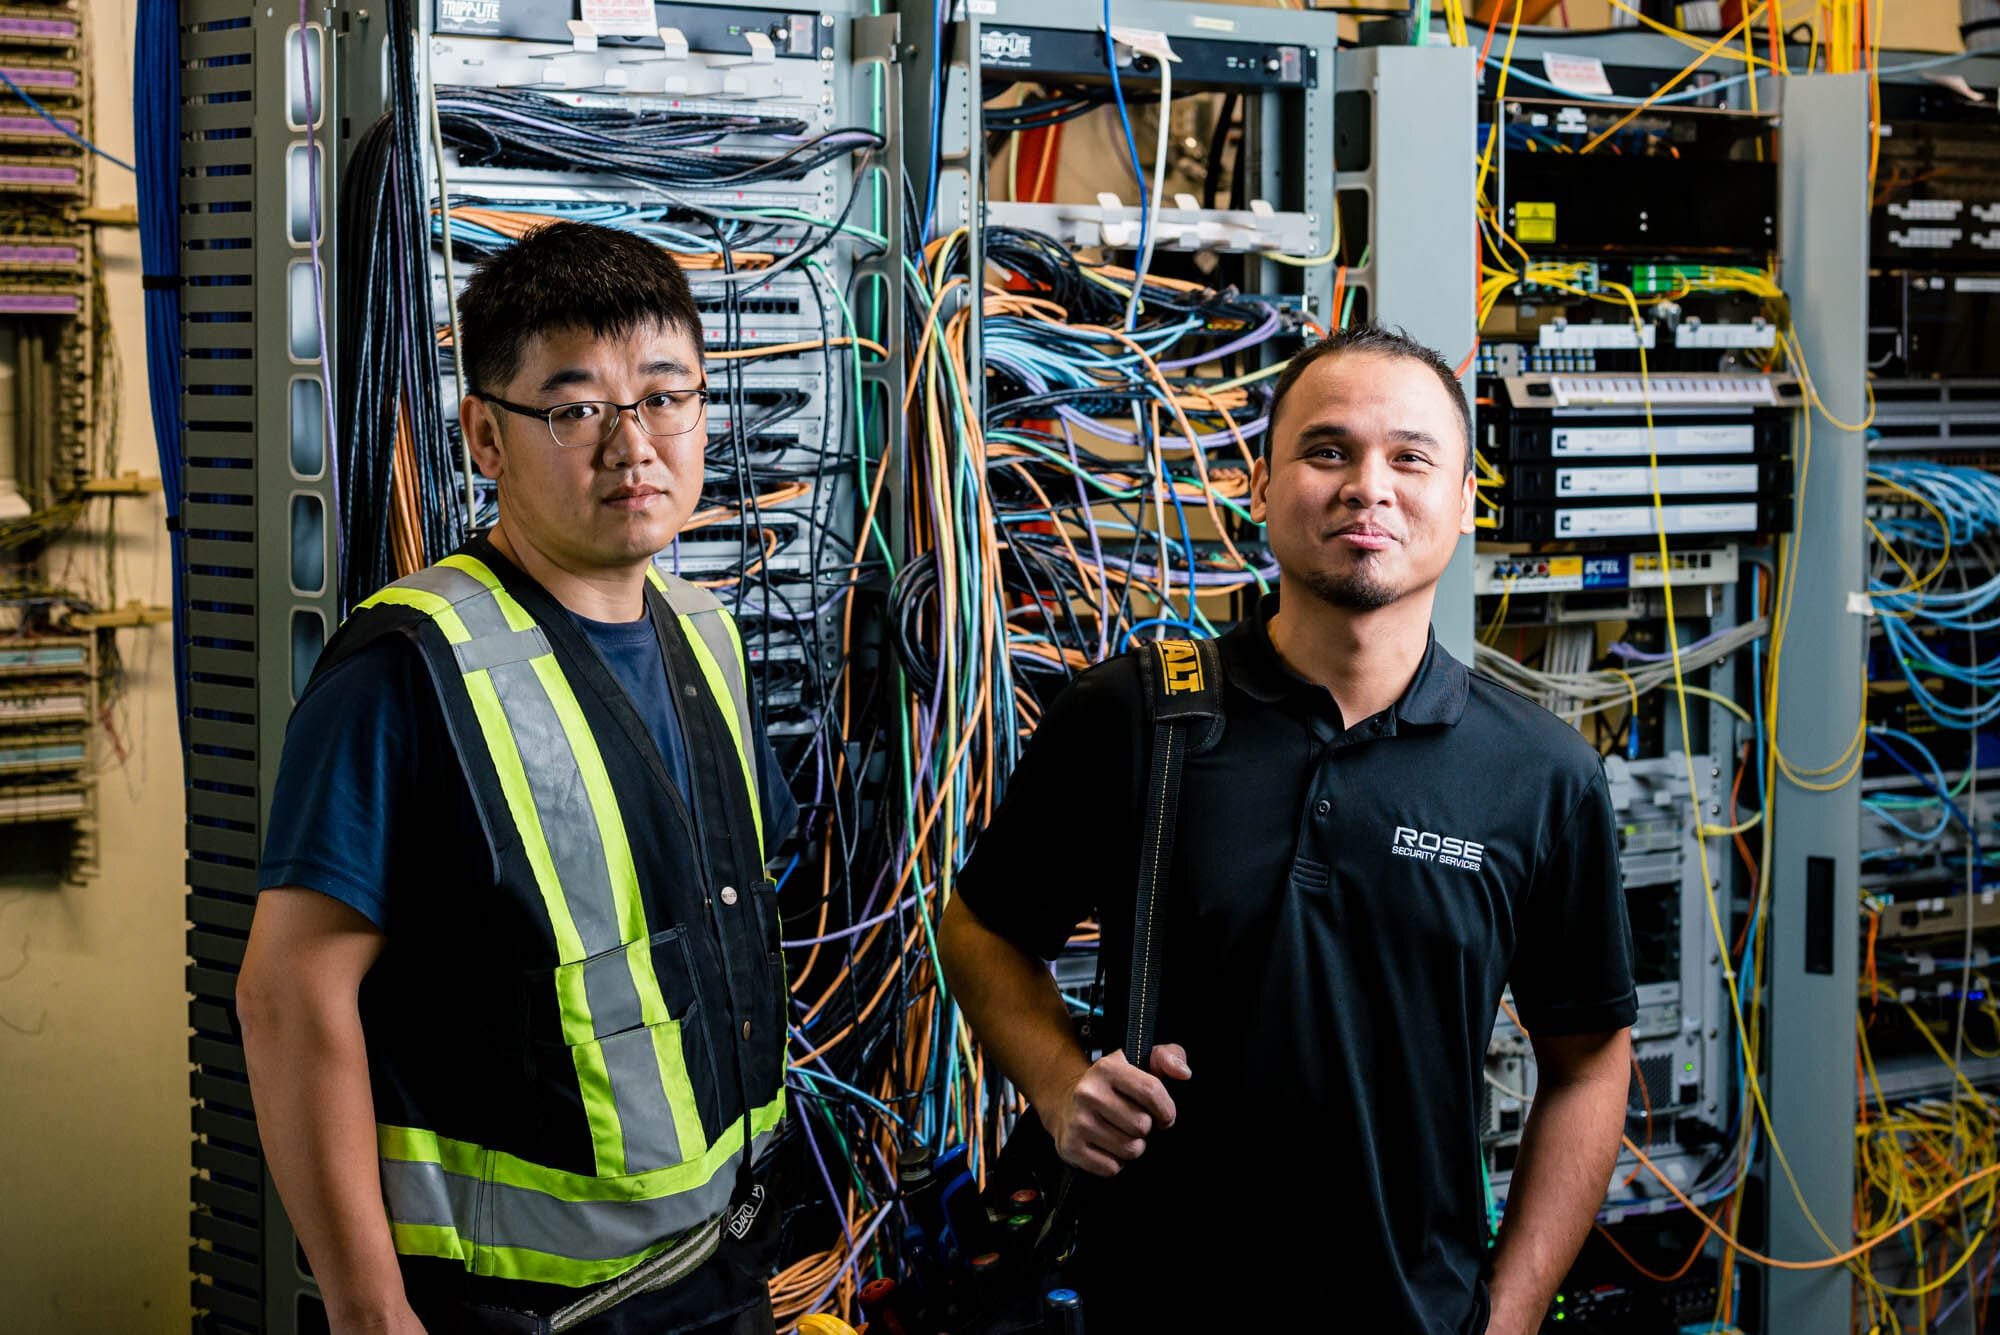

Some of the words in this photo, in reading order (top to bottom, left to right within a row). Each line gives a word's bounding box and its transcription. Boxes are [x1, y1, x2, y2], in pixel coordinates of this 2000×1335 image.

[1392, 845, 1437, 862] SECURITY
[1439, 854, 1481, 872] SERVICES
[1393, 826, 1485, 863] ROSE
